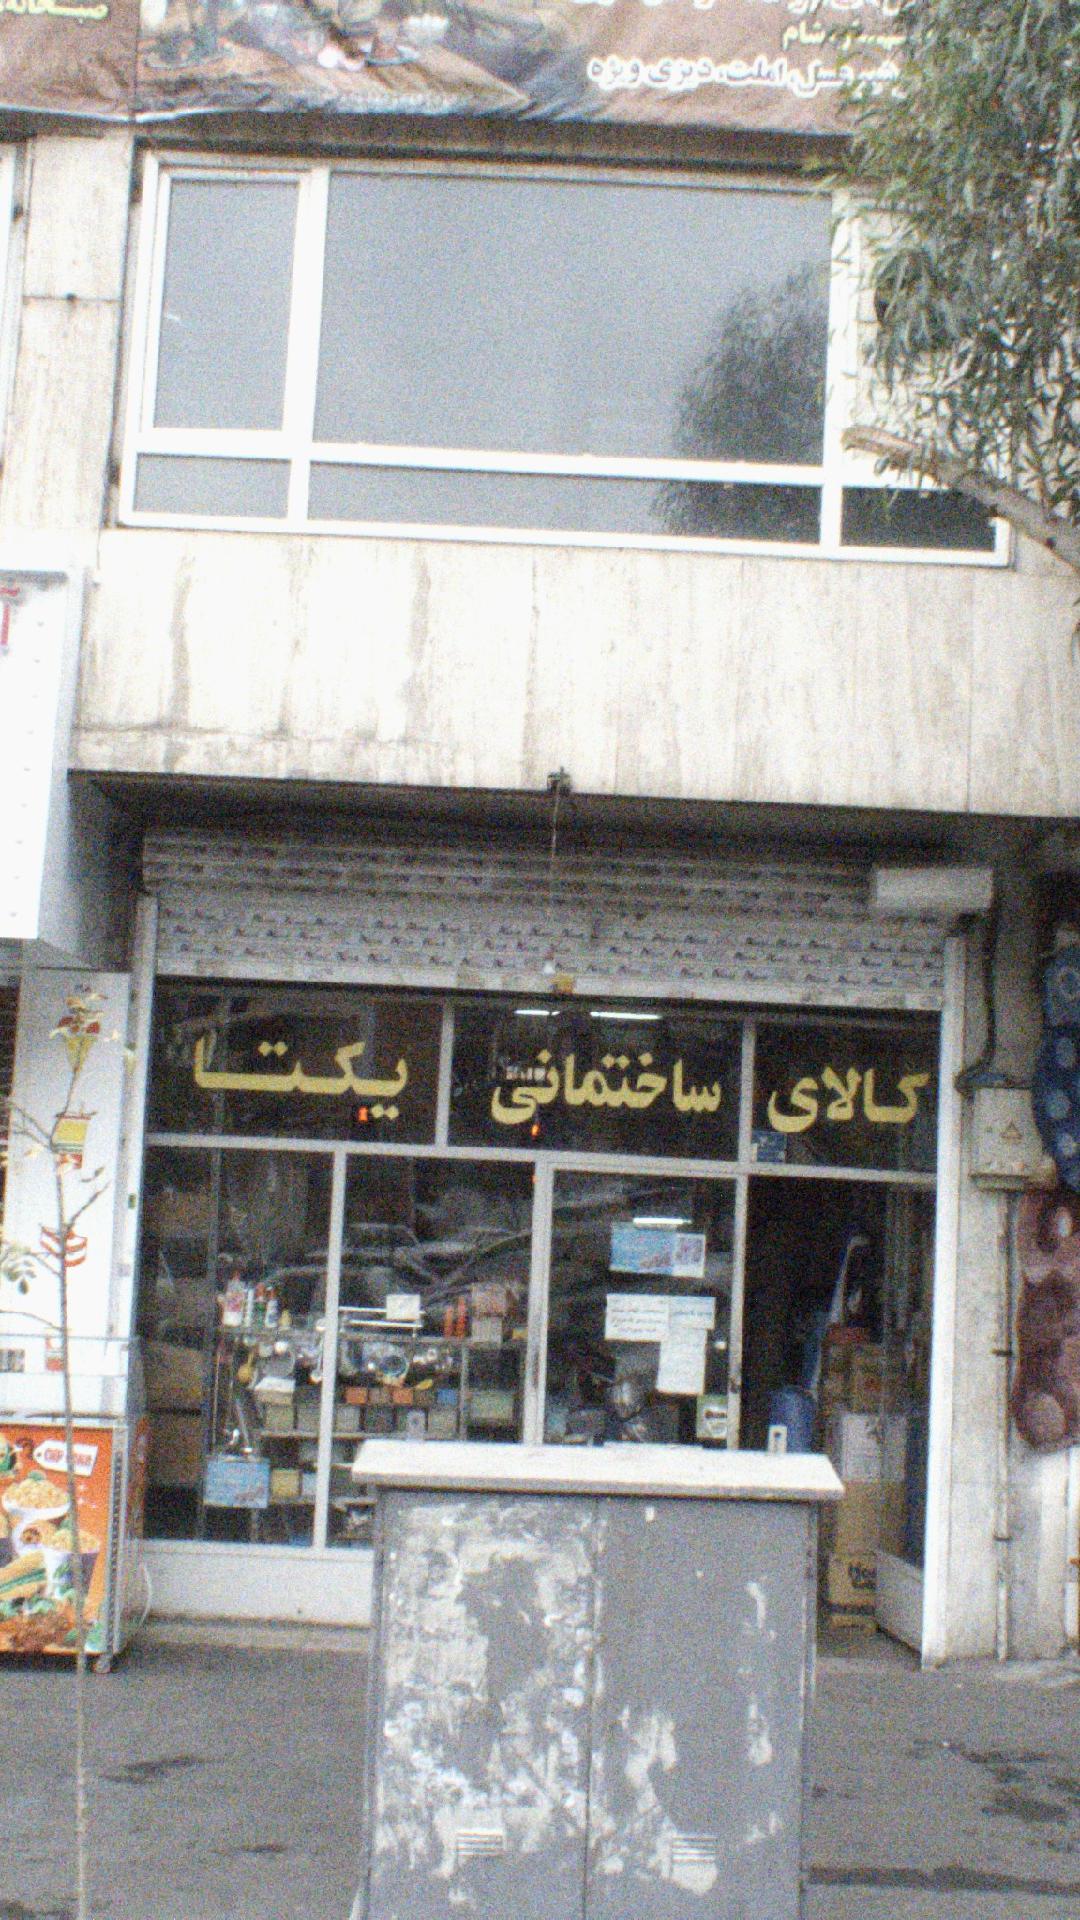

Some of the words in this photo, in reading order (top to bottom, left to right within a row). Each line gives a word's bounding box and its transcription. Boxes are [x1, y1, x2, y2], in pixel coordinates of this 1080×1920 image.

[587, 55, 645, 92] ویژه
[647, 56, 715, 92] دیزی
[193, 1034, 409, 1121] یکتا
[490, 1048, 722, 1126] ساختمانی
[767, 1065, 930, 1133] کالای
